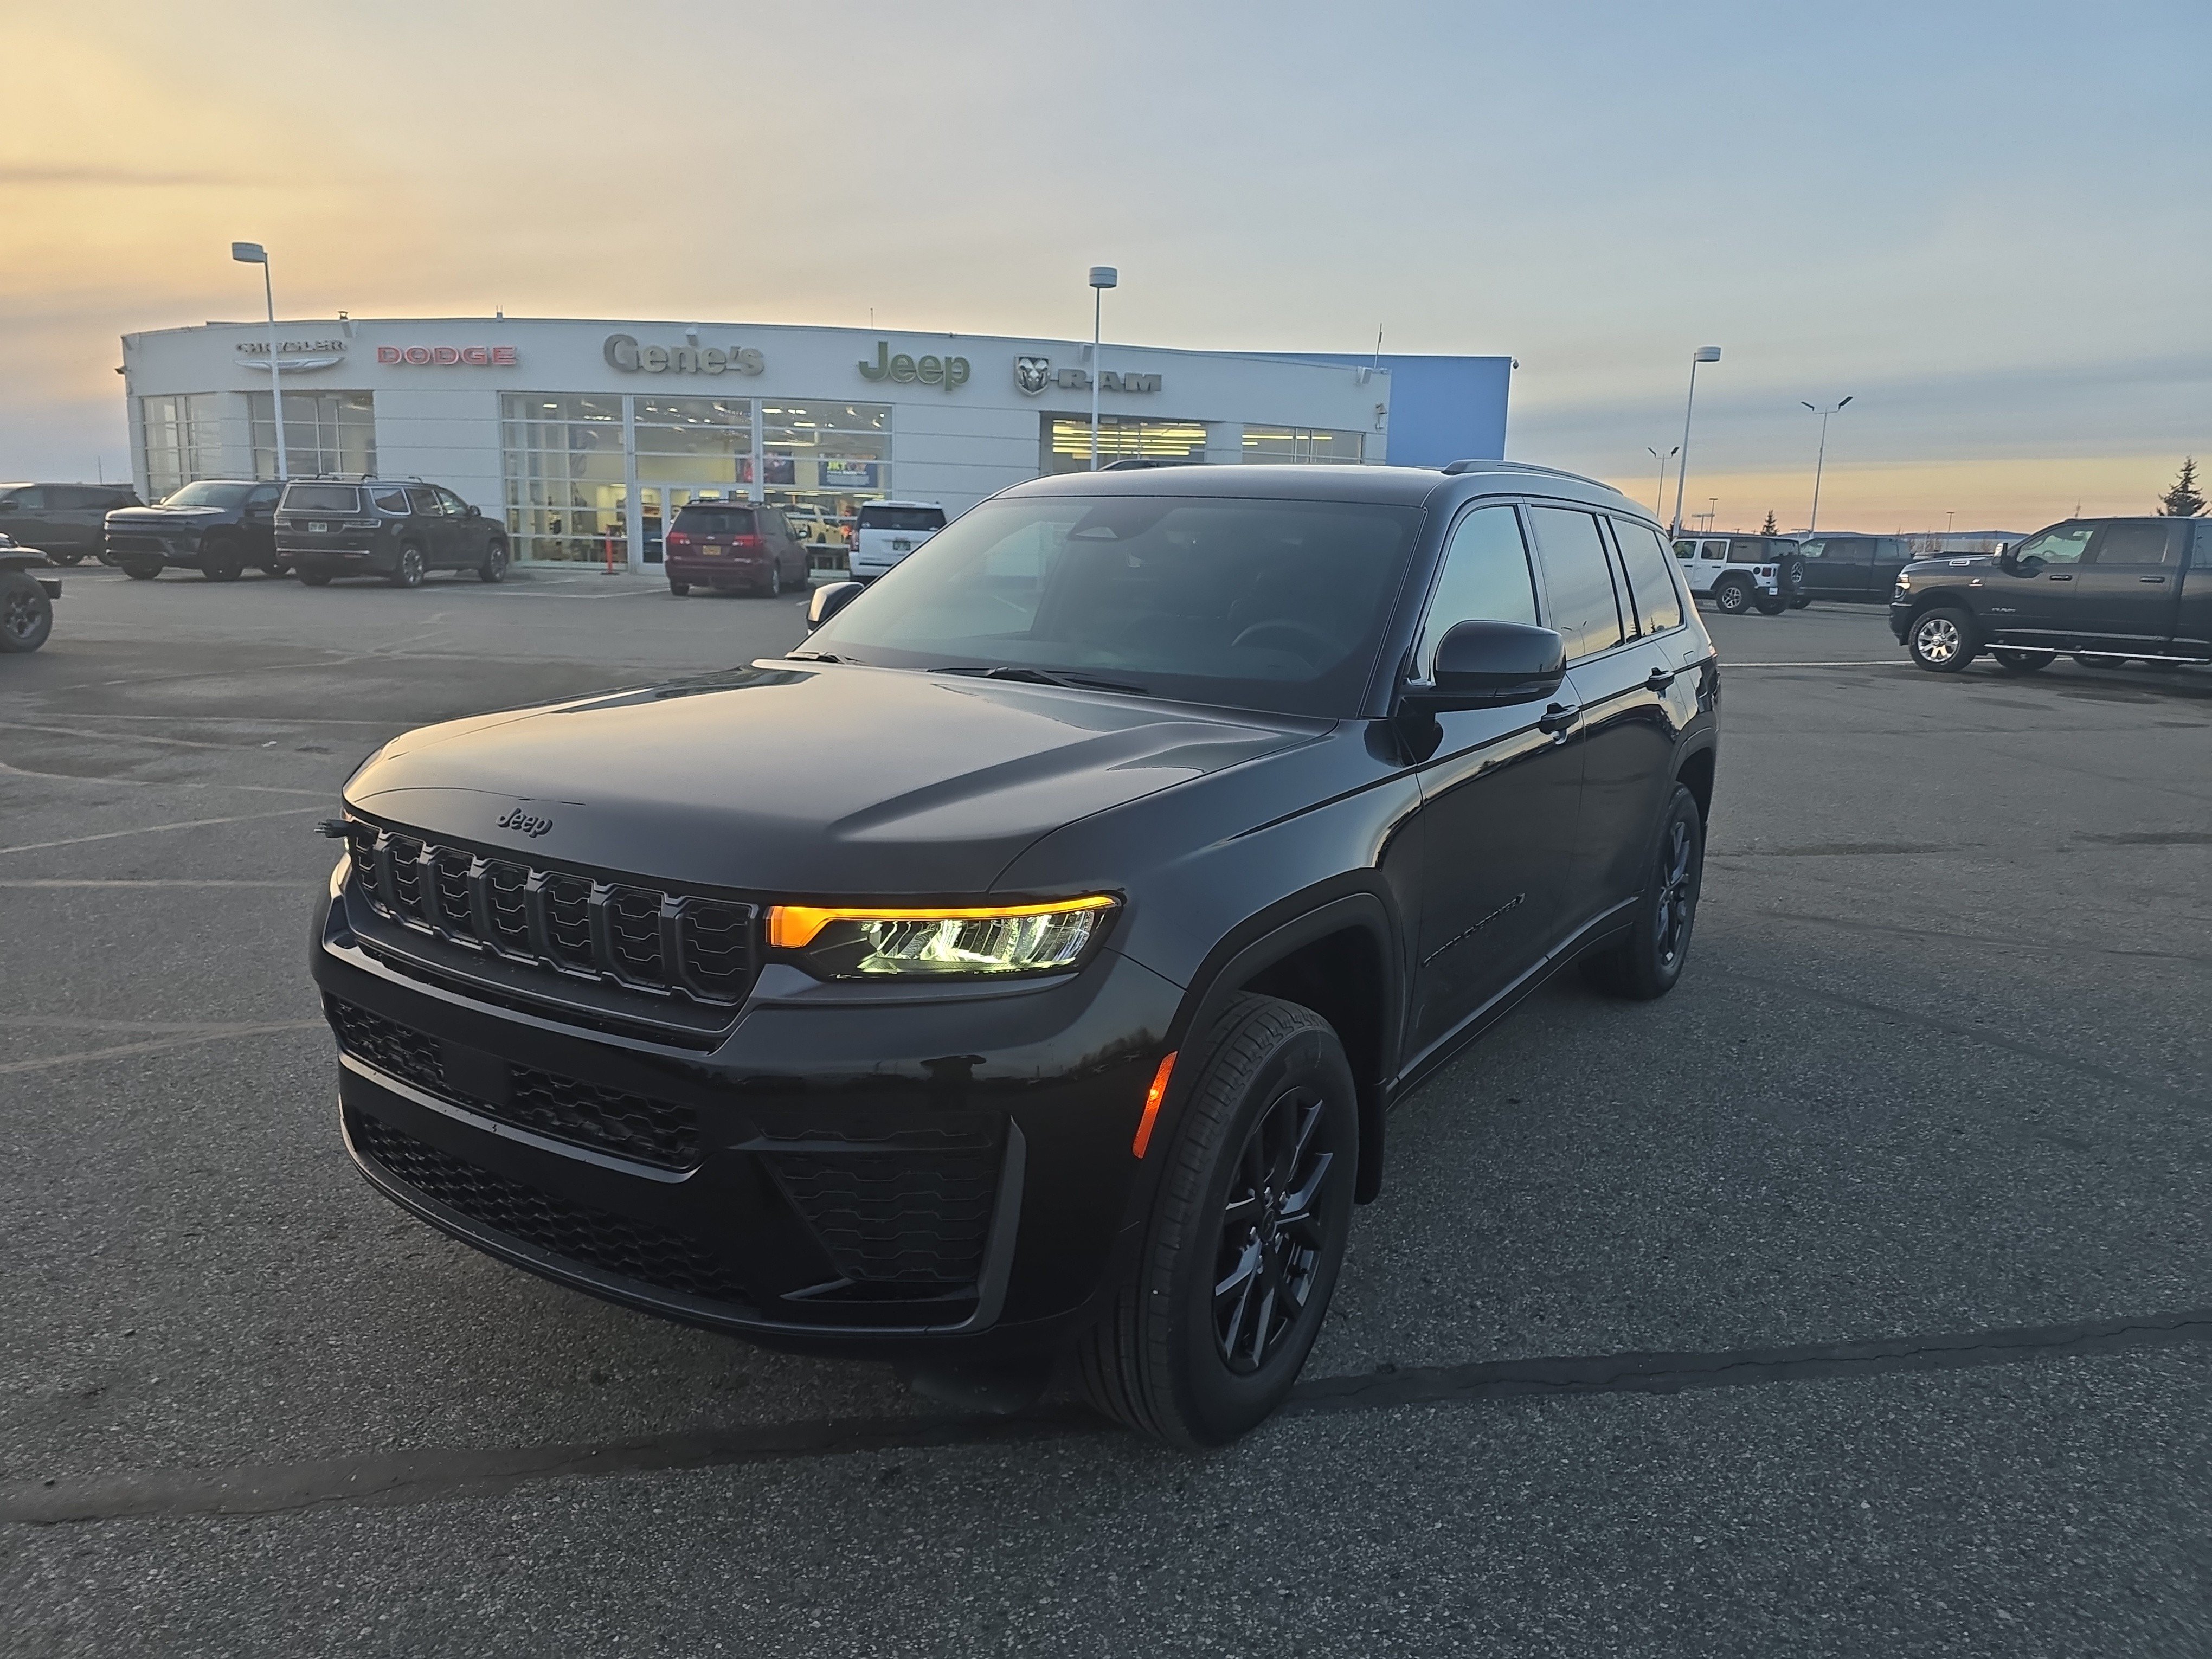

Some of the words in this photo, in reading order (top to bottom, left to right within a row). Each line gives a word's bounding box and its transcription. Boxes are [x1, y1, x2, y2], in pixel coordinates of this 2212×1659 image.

[376, 345, 517, 365] DODGE
[603, 334, 764, 376] Gene's
[858, 341, 970, 391] Jeep
[1058, 368, 1162, 392] RAM
[496, 807, 554, 839] Jeep
